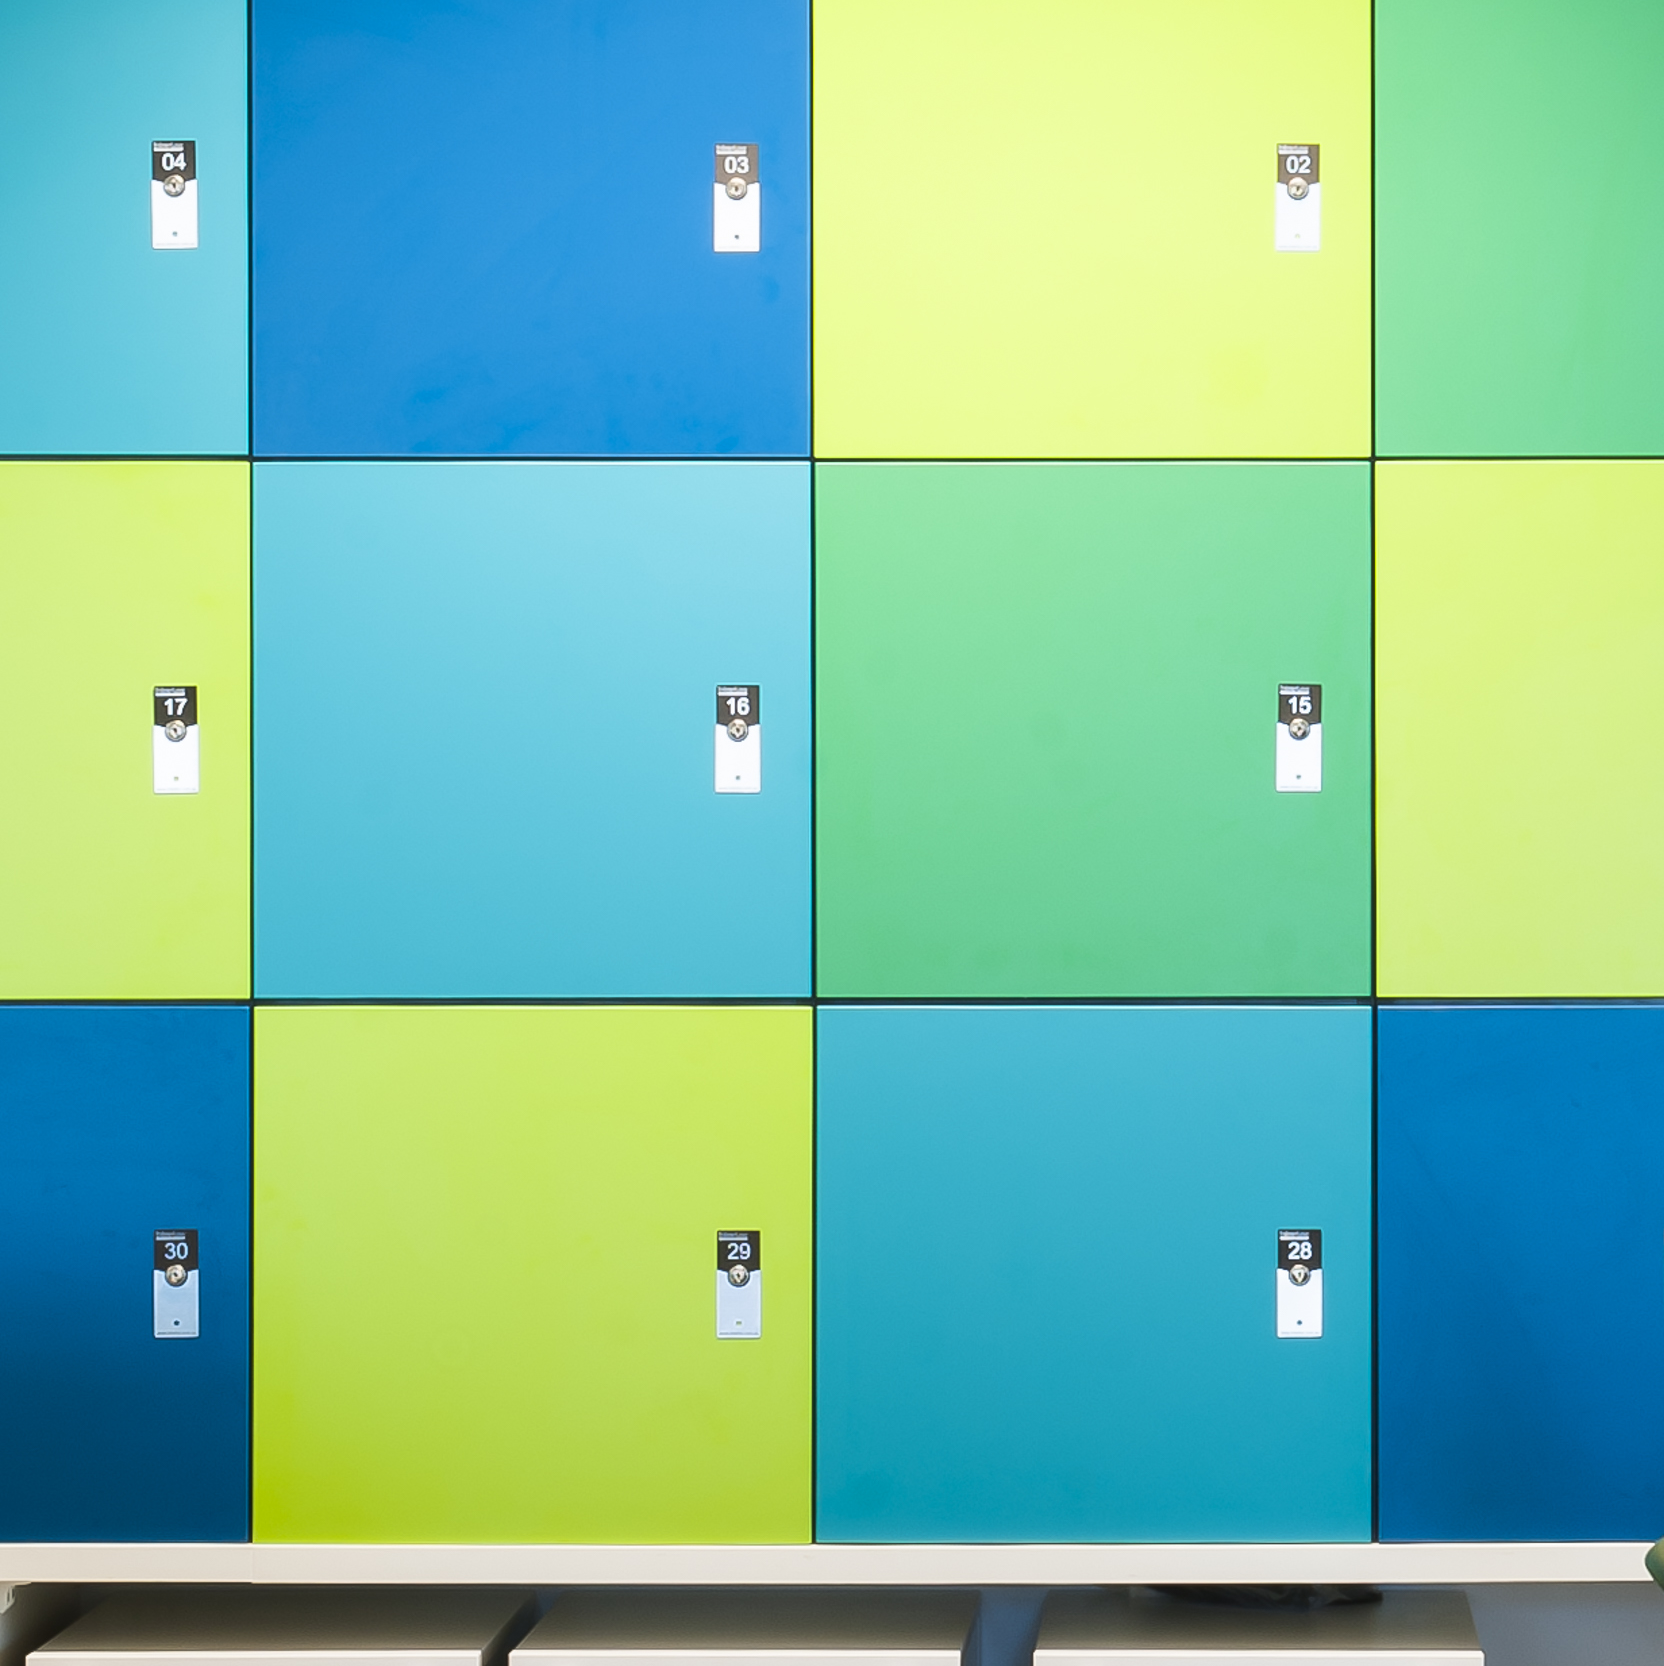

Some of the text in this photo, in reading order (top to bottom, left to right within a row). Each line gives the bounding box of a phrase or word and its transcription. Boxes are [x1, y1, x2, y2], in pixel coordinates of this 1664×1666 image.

[162, 153, 186, 171] 04
[724, 156, 749, 173] 03
[1286, 155, 1311, 174] 02
[164, 698, 188, 715] 17
[726, 697, 750, 715] 16
[1288, 696, 1312, 714] 15
[164, 1243, 188, 1259] 30
[728, 1243, 750, 1260] 29
[1288, 1241, 1312, 1260] 28
